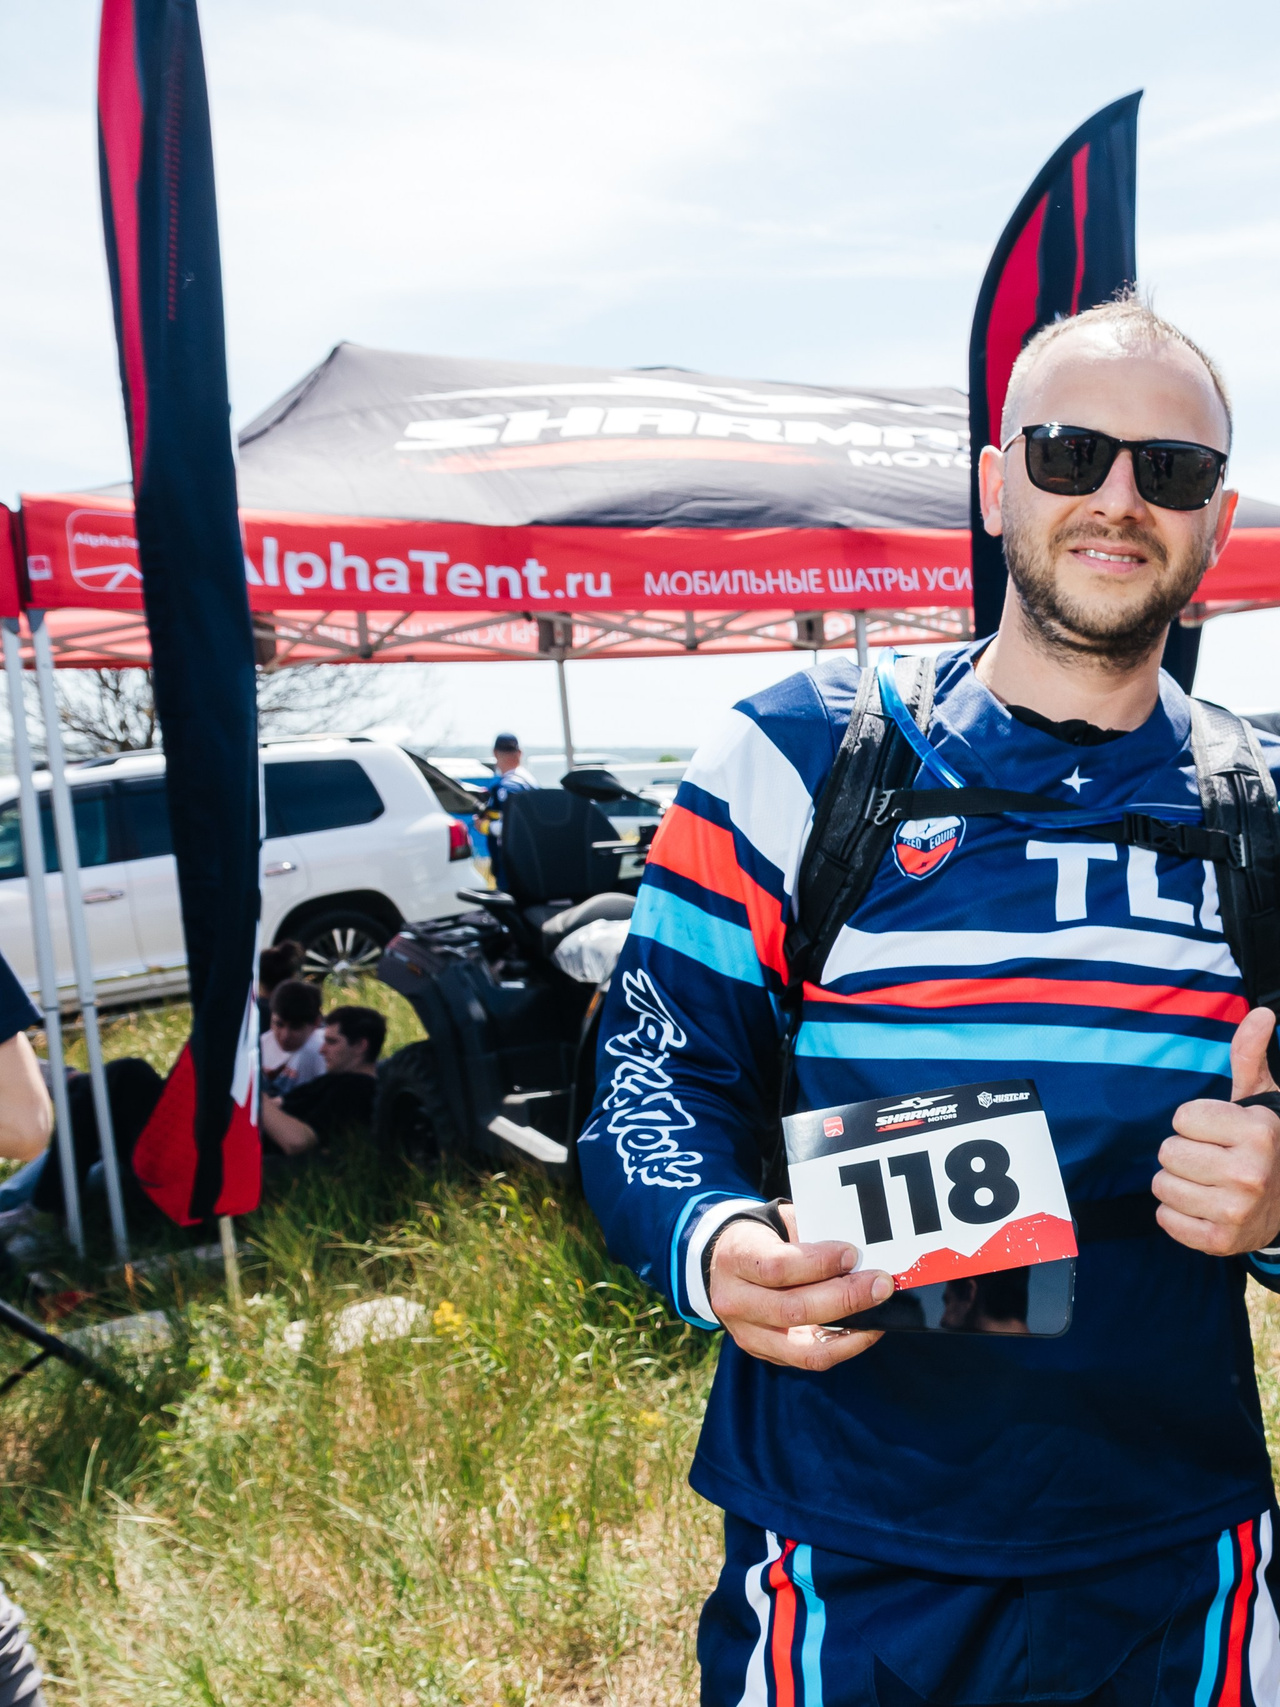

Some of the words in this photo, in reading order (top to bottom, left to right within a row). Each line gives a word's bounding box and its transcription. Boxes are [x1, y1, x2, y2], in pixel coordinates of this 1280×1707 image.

[394, 406, 971, 452] SHARMA
[246, 537, 612, 599] lphaTent.ru
[644, 569, 825, 596] МОБИЛЬНЫЕ
[828, 567, 920, 594] ШАТРЫ
[922, 567, 973, 592] УСИ
[874, 1103, 958, 1127] SHARMAX
[927, 1113, 957, 1123] MOTORS
[838, 1139, 1020, 1245] 118
